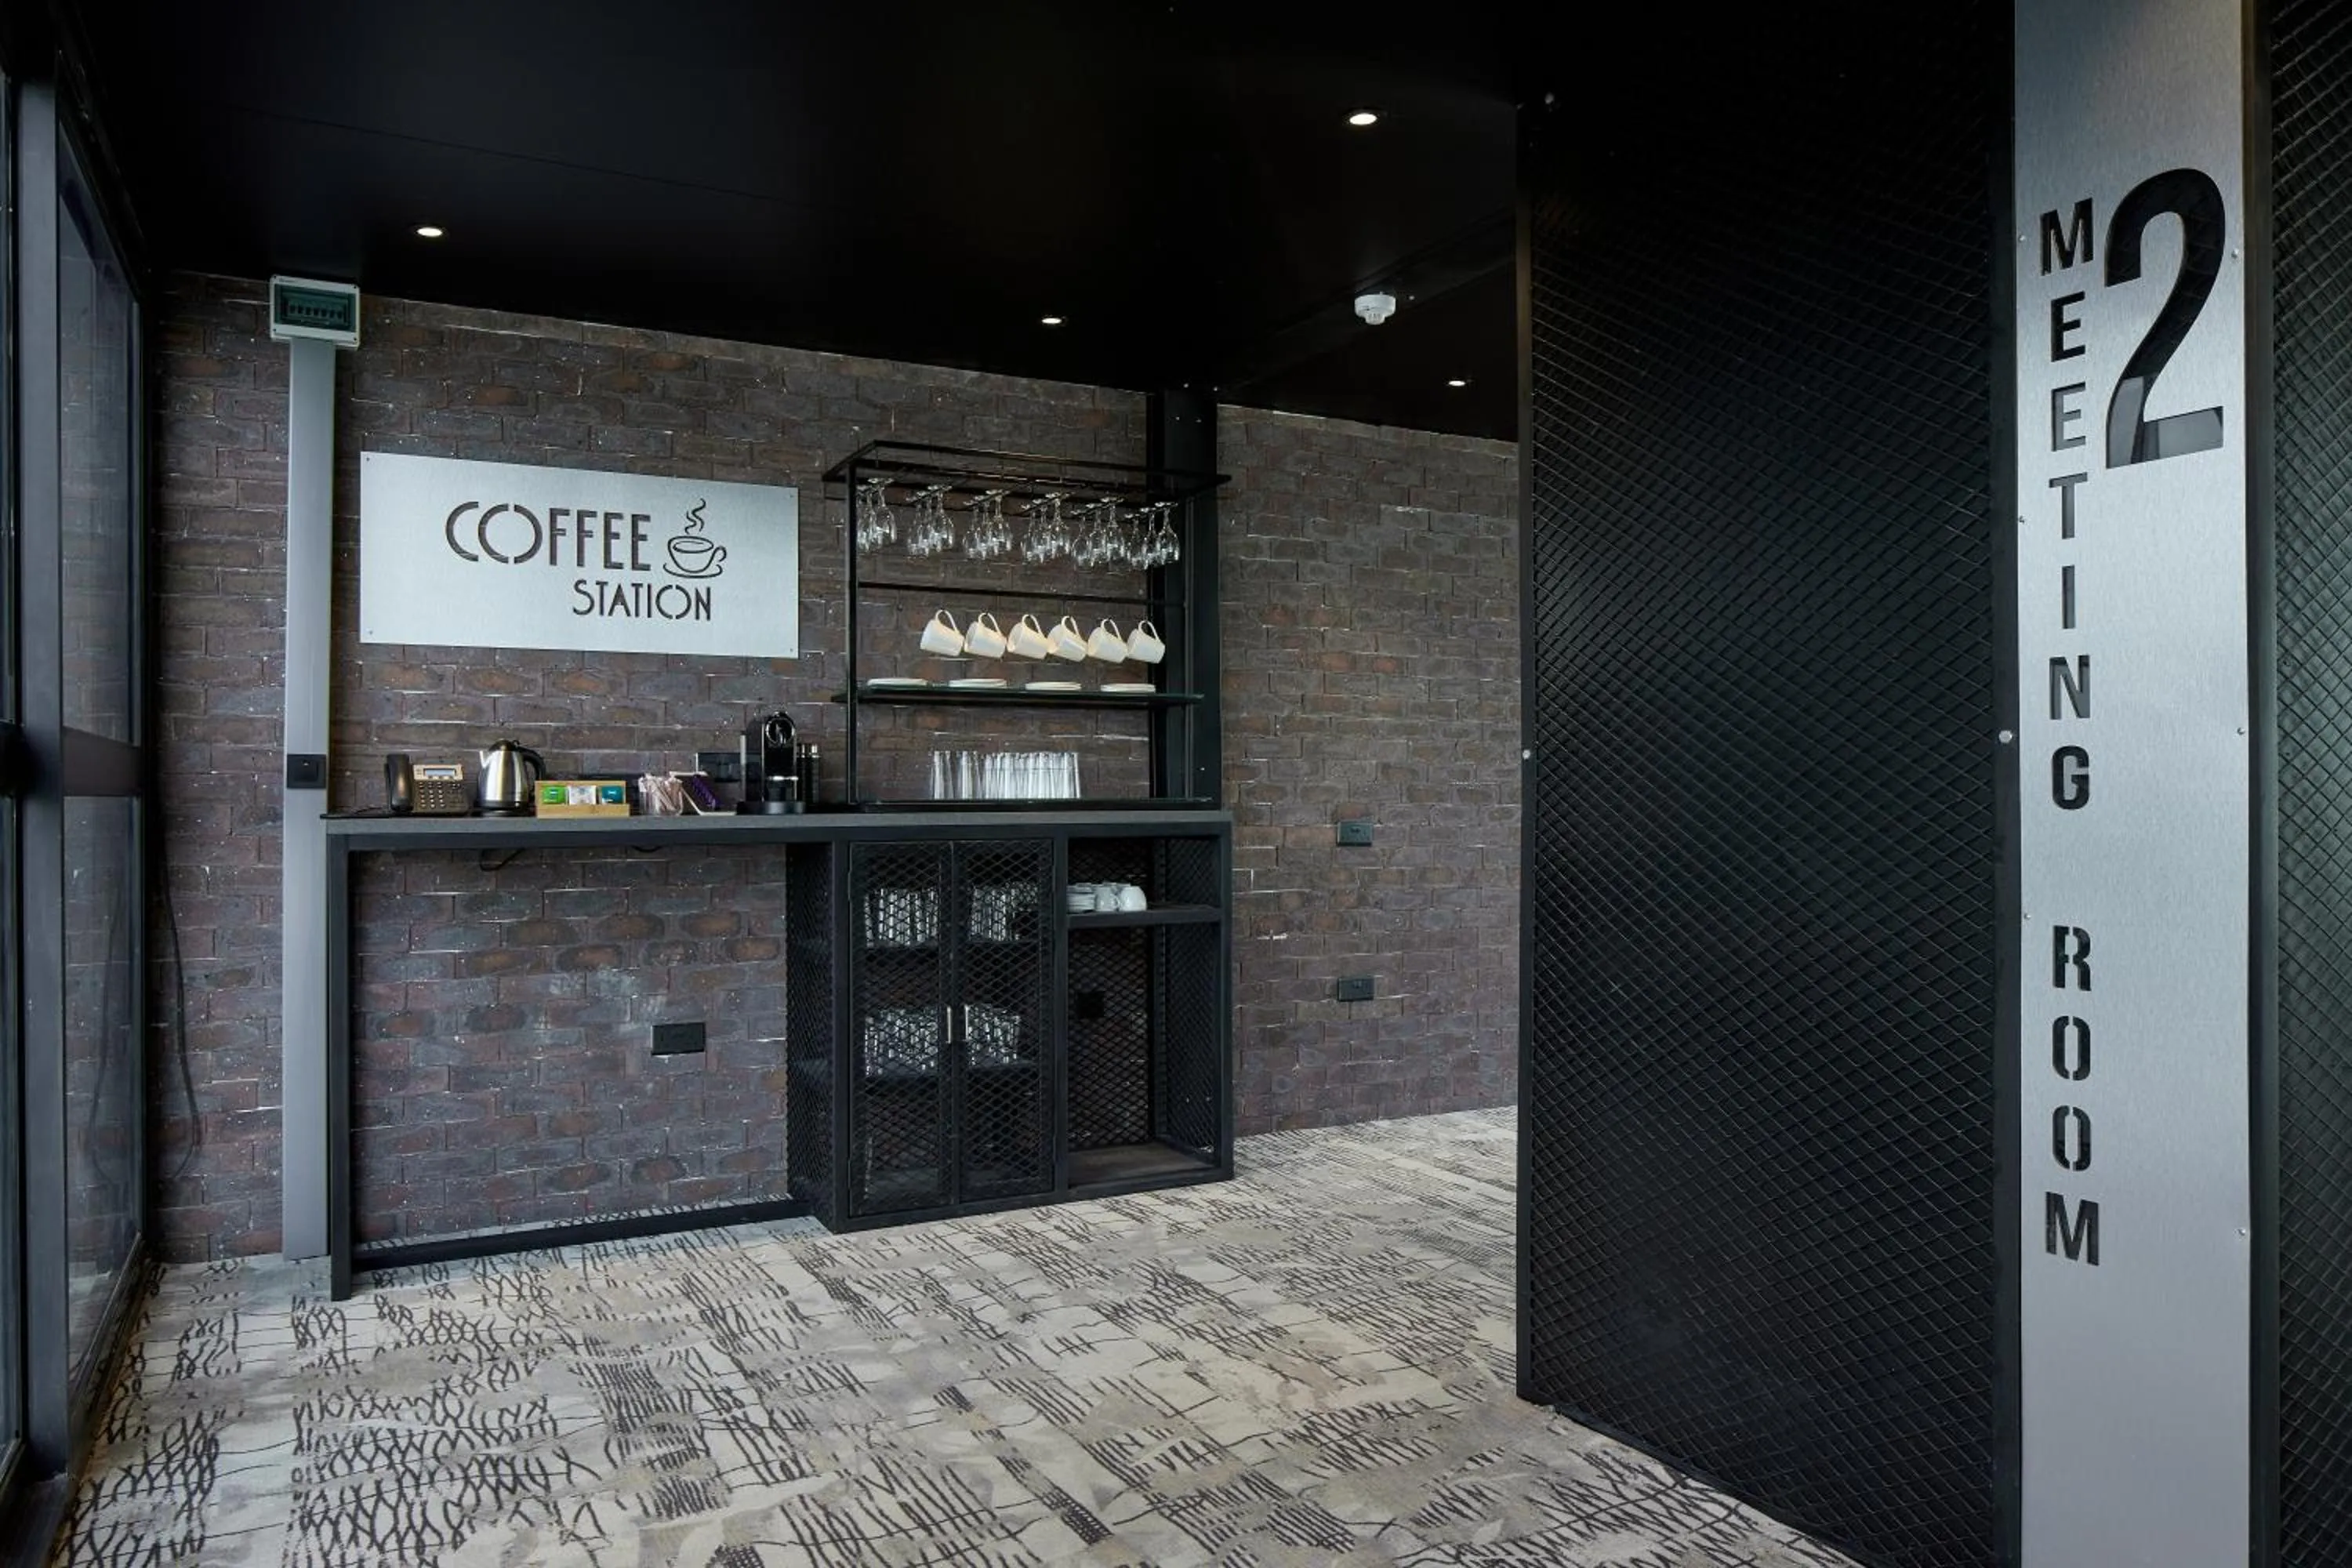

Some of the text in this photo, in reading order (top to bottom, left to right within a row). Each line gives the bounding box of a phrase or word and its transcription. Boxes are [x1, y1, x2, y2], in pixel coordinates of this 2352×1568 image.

[2104, 168, 2226, 469] 2
[445, 501, 652, 572] COFFEE
[572, 579, 712, 621] STATION
[2040, 197, 2100, 1267] MEETING ROOM
